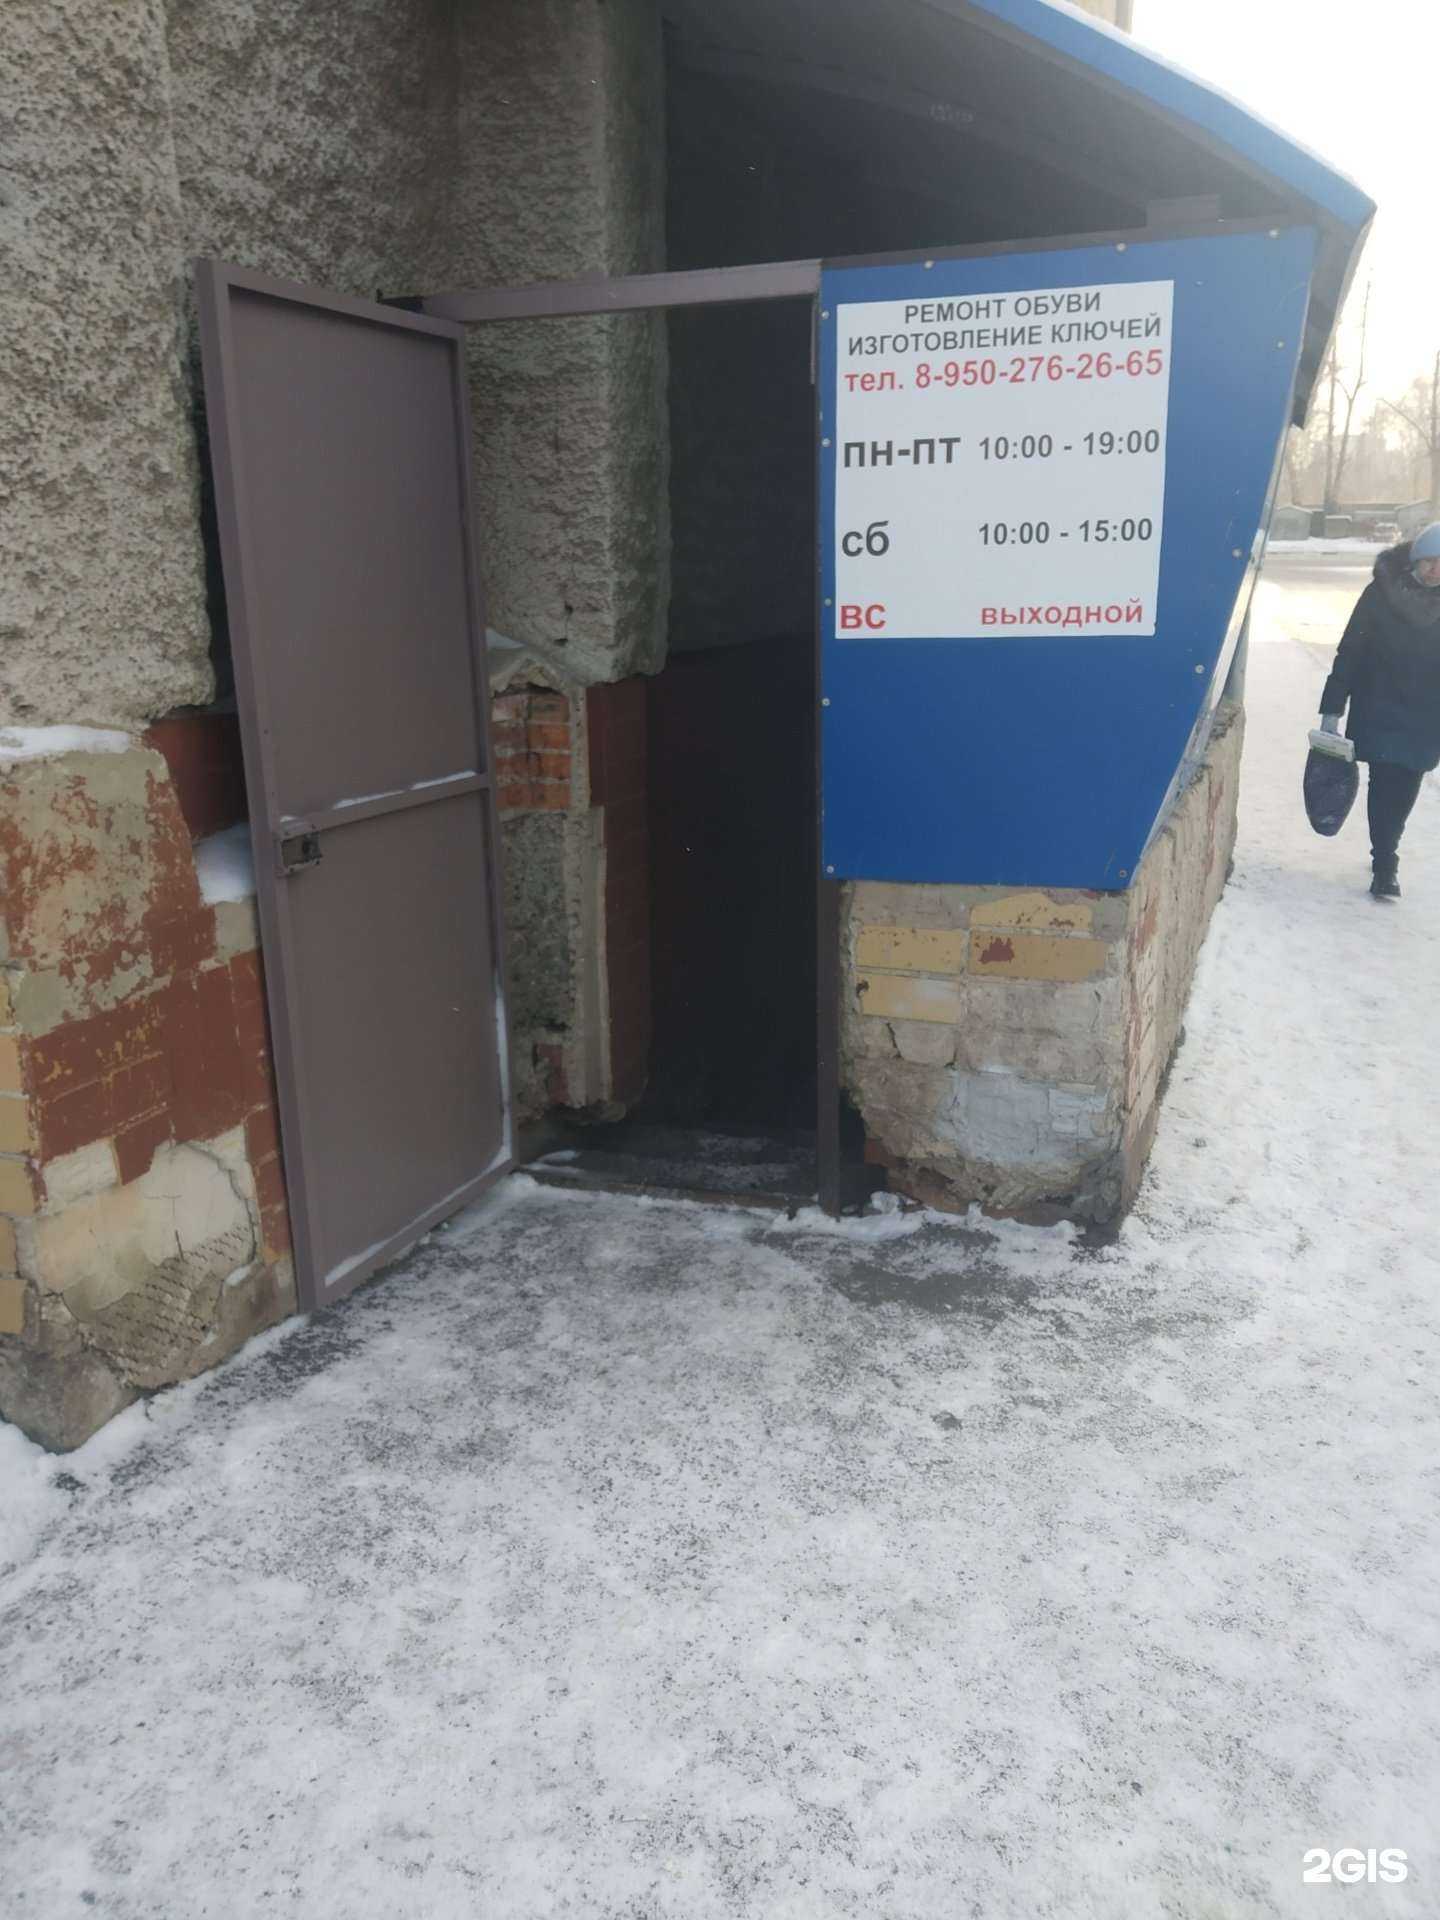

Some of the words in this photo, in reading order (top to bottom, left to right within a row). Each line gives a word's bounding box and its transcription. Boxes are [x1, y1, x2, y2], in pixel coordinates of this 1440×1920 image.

[905, 299, 1006, 323] РЕМОНТ
[1015, 293, 1100, 316] ОБУВИ
[849, 326, 1041, 355] ИЗГОТОВЛЕНИЕ
[1051, 312, 1161, 343] КЛЮЧЕЙ
[845, 371, 904, 392] тел.
[916, 350, 1162, 388] 8-950-276-26-65
[979, 434, 1053, 460] 10:00
[1083, 430, 1160, 456] 19:00
[842, 520, 889, 557] сб
[979, 521, 1050, 545] 10:00
[1080, 518, 1153, 543] 15:00
[981, 598, 1143, 628] выходной
